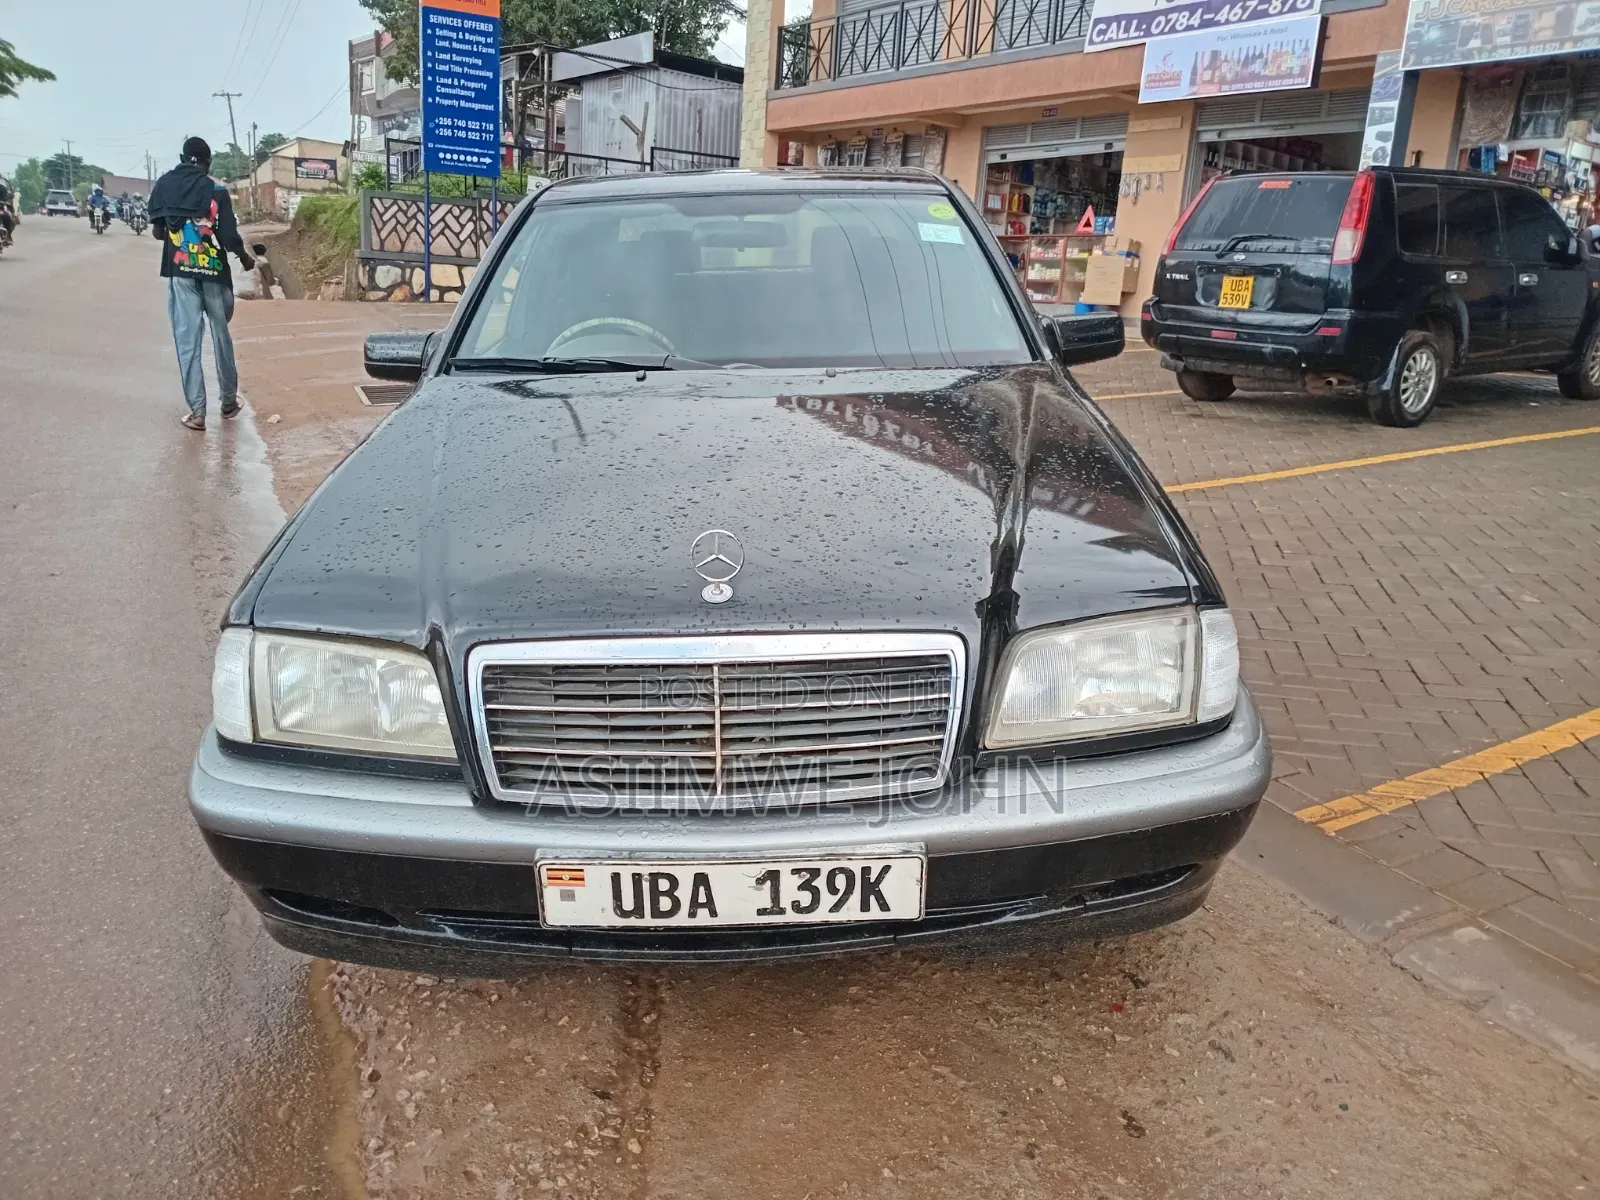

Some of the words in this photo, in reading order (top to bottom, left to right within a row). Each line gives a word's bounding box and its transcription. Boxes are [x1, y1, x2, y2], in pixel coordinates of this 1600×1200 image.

[430, 14, 462, 28] SERVICES
[464, 20, 494, 32] OFFERED
[436, 28, 456, 39] Selling
[465, 33, 486, 43] Buying
[1092, 19, 1146, 42] CALL:
[436, 39, 450, 48] Land,
[452, 41, 472, 50] Houses
[479, 46, 496, 54] Farms
[436, 52, 450, 60] Land
[452, 54, 482, 66] Surveying
[436, 63, 449, 71] Land
[450, 65, 462, 73] Title
[464, 67, 493, 79] Processing
[436, 76, 452, 85] Land
[453, 78, 458, 86] &
[460, 79, 487, 90] Property
[436, 85, 475, 98] Consultancy
[436, 97, 459, 108] Property
[460, 100, 494, 111] Management
[435, 117, 452, 126] +256
[453, 119, 466, 127] 740
[468, 121, 480, 129] 522
[481, 123, 494, 131] 718
[435, 128, 452, 136] +256
[453, 130, 466, 138] 740
[468, 132, 480, 140] 522
[482, 133, 494, 141] 717
[180, 241, 217, 258] SUPER
[173, 250, 223, 270] MARIO
[1230, 279, 1249, 292] UBA
[1221, 292, 1248, 306] 539V
[610, 871, 718, 920] UBA
[754, 864, 893, 917] 139K
